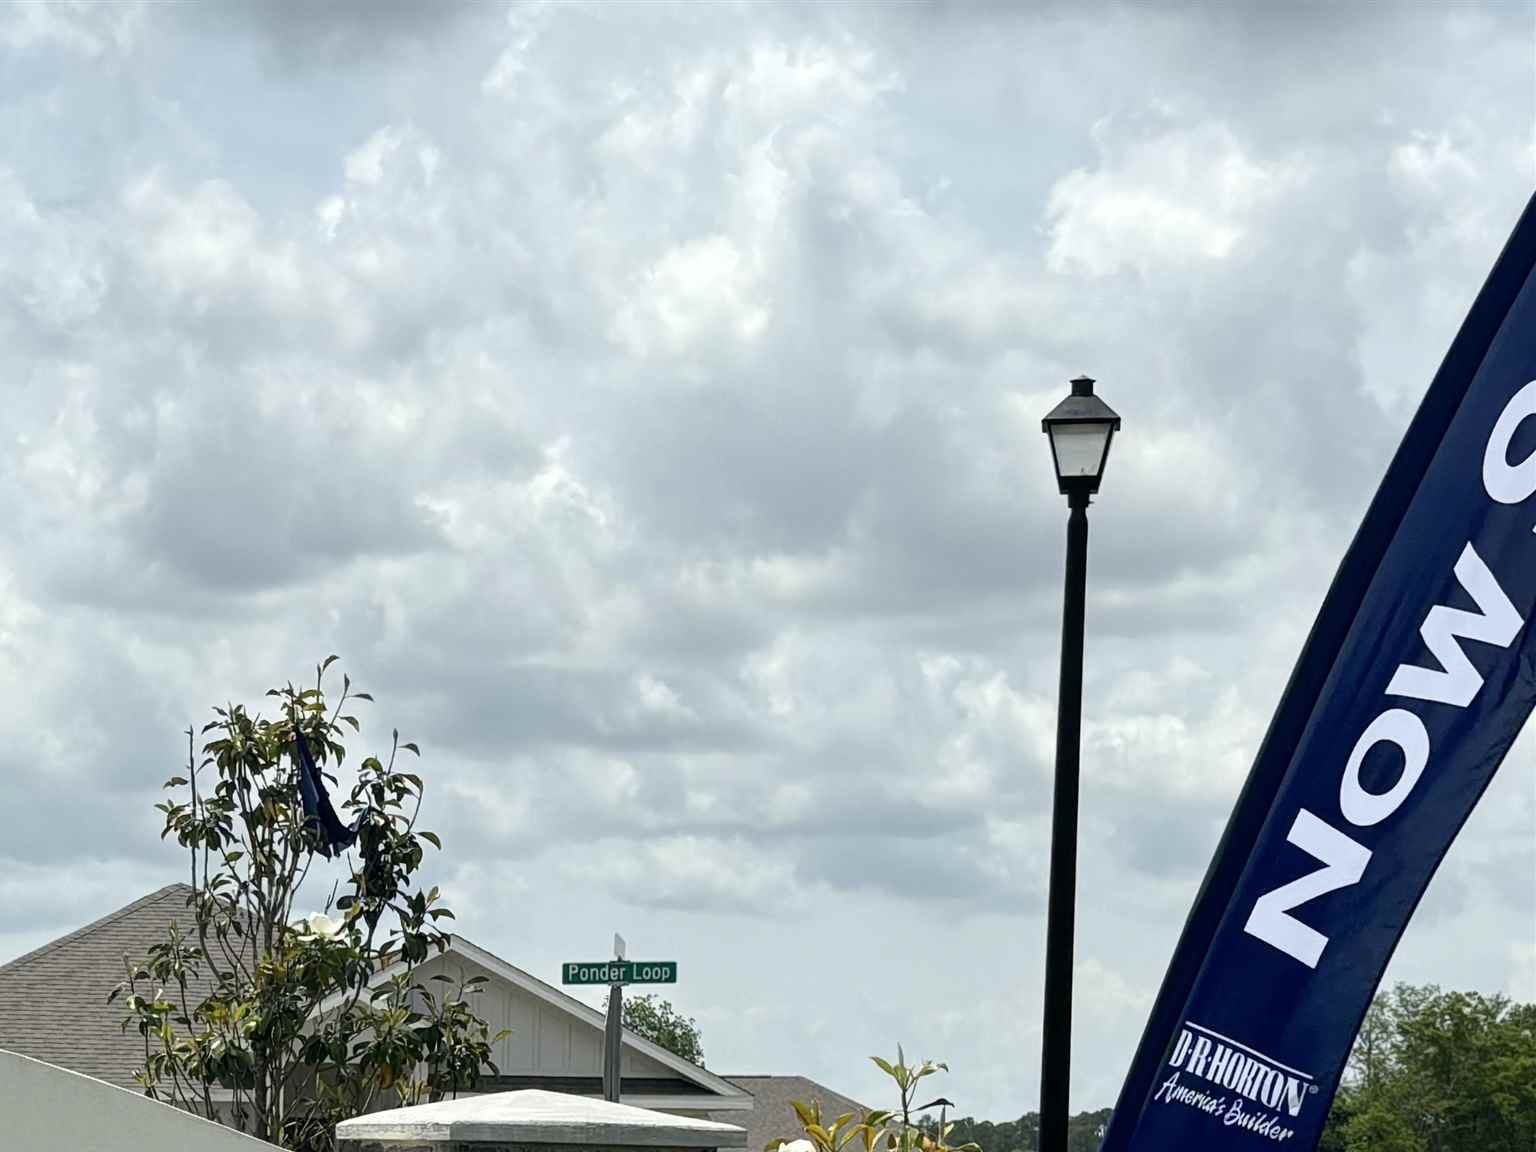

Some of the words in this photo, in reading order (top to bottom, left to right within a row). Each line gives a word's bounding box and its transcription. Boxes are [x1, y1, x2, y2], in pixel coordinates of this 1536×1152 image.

[568, 964, 626, 981] Ponder
[632, 963, 671, 980] Loop
[1154, 1071, 1226, 1117] America's
[1224, 1098, 1294, 1142] Builder
